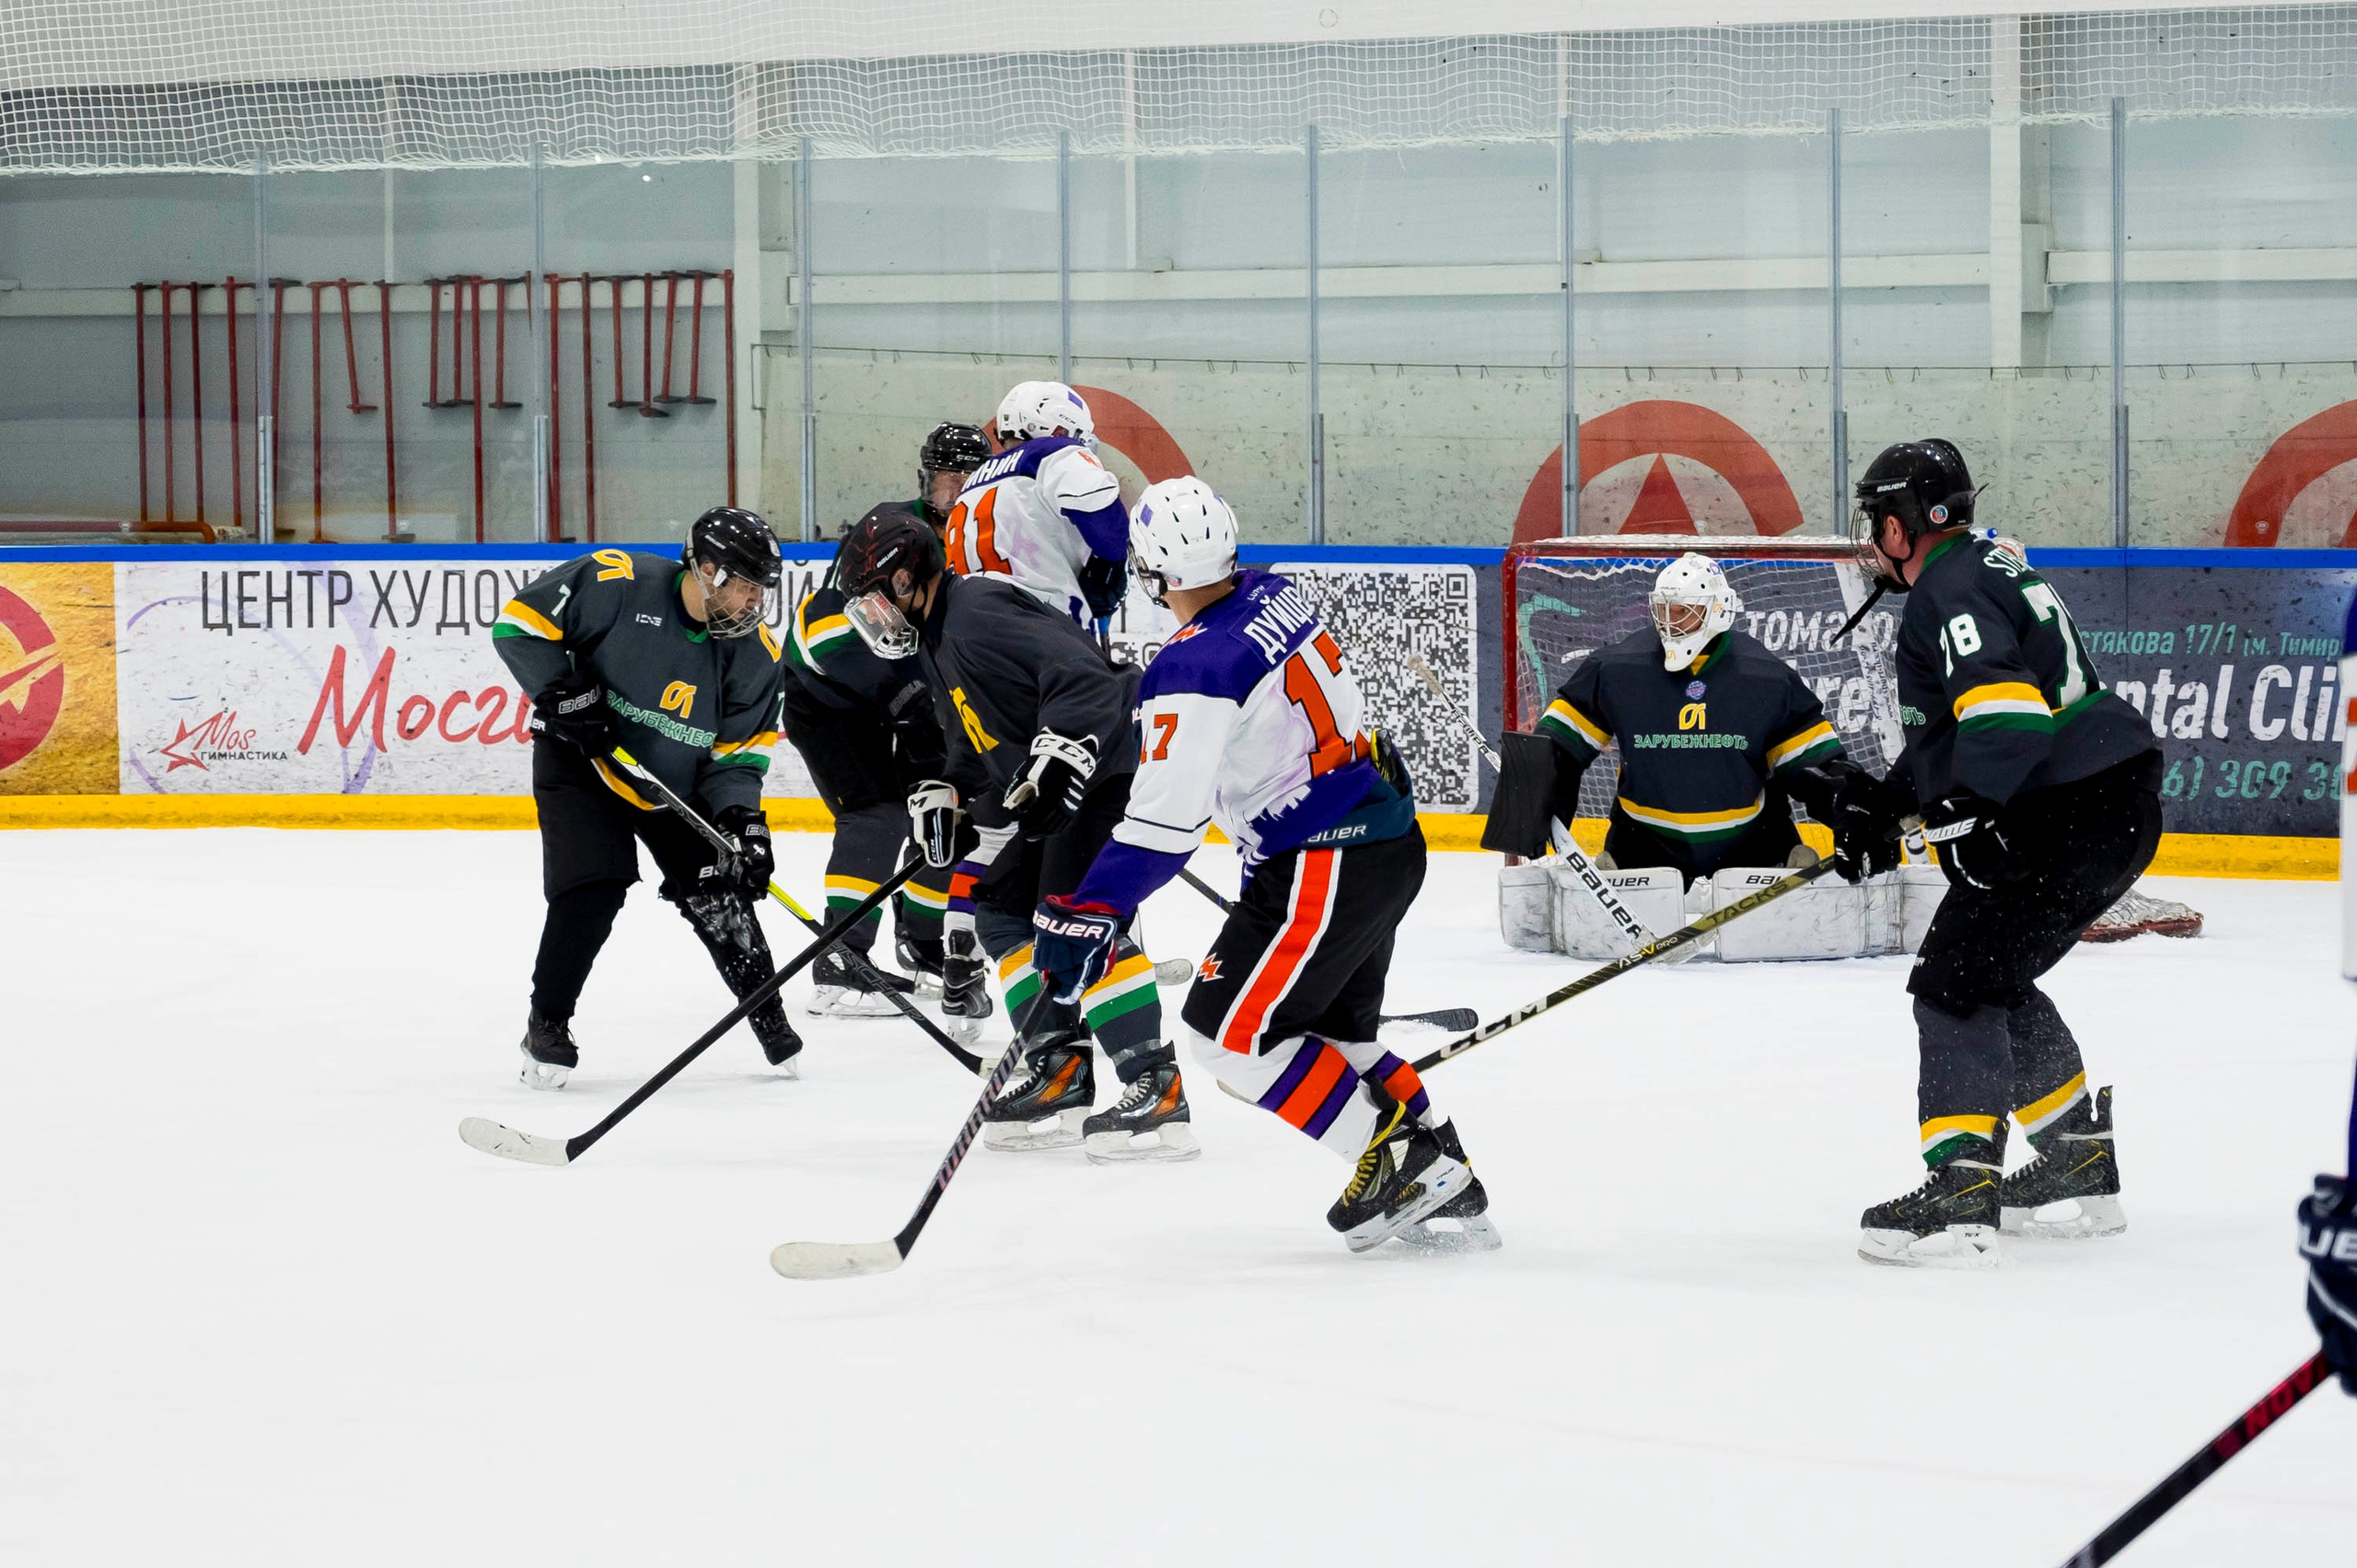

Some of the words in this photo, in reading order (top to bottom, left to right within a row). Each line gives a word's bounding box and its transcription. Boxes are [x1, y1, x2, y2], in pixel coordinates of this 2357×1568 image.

[202, 570, 353, 636] ЦЕНТР
[551, 584, 571, 617] 7
[2185, 621, 2236, 656] 17/1
[2280, 632, 2343, 662] Тимир
[607, 690, 716, 749] ЗАРУБЕЖНЕФ
[2115, 665, 2235, 739] ntal
[201, 751, 288, 761] ГИМНАСТИКА
[1035, 738, 1095, 773] CCM
[1634, 734, 1748, 750] ЗАРУБЕЖНЕФТЬ
[2163, 756, 2204, 801] 6)
[2215, 760, 2292, 799] 309
[1705, 879, 1788, 924] TACKS
[1656, 936, 1678, 950] PRO
[1440, 995, 1548, 1059] CCM
